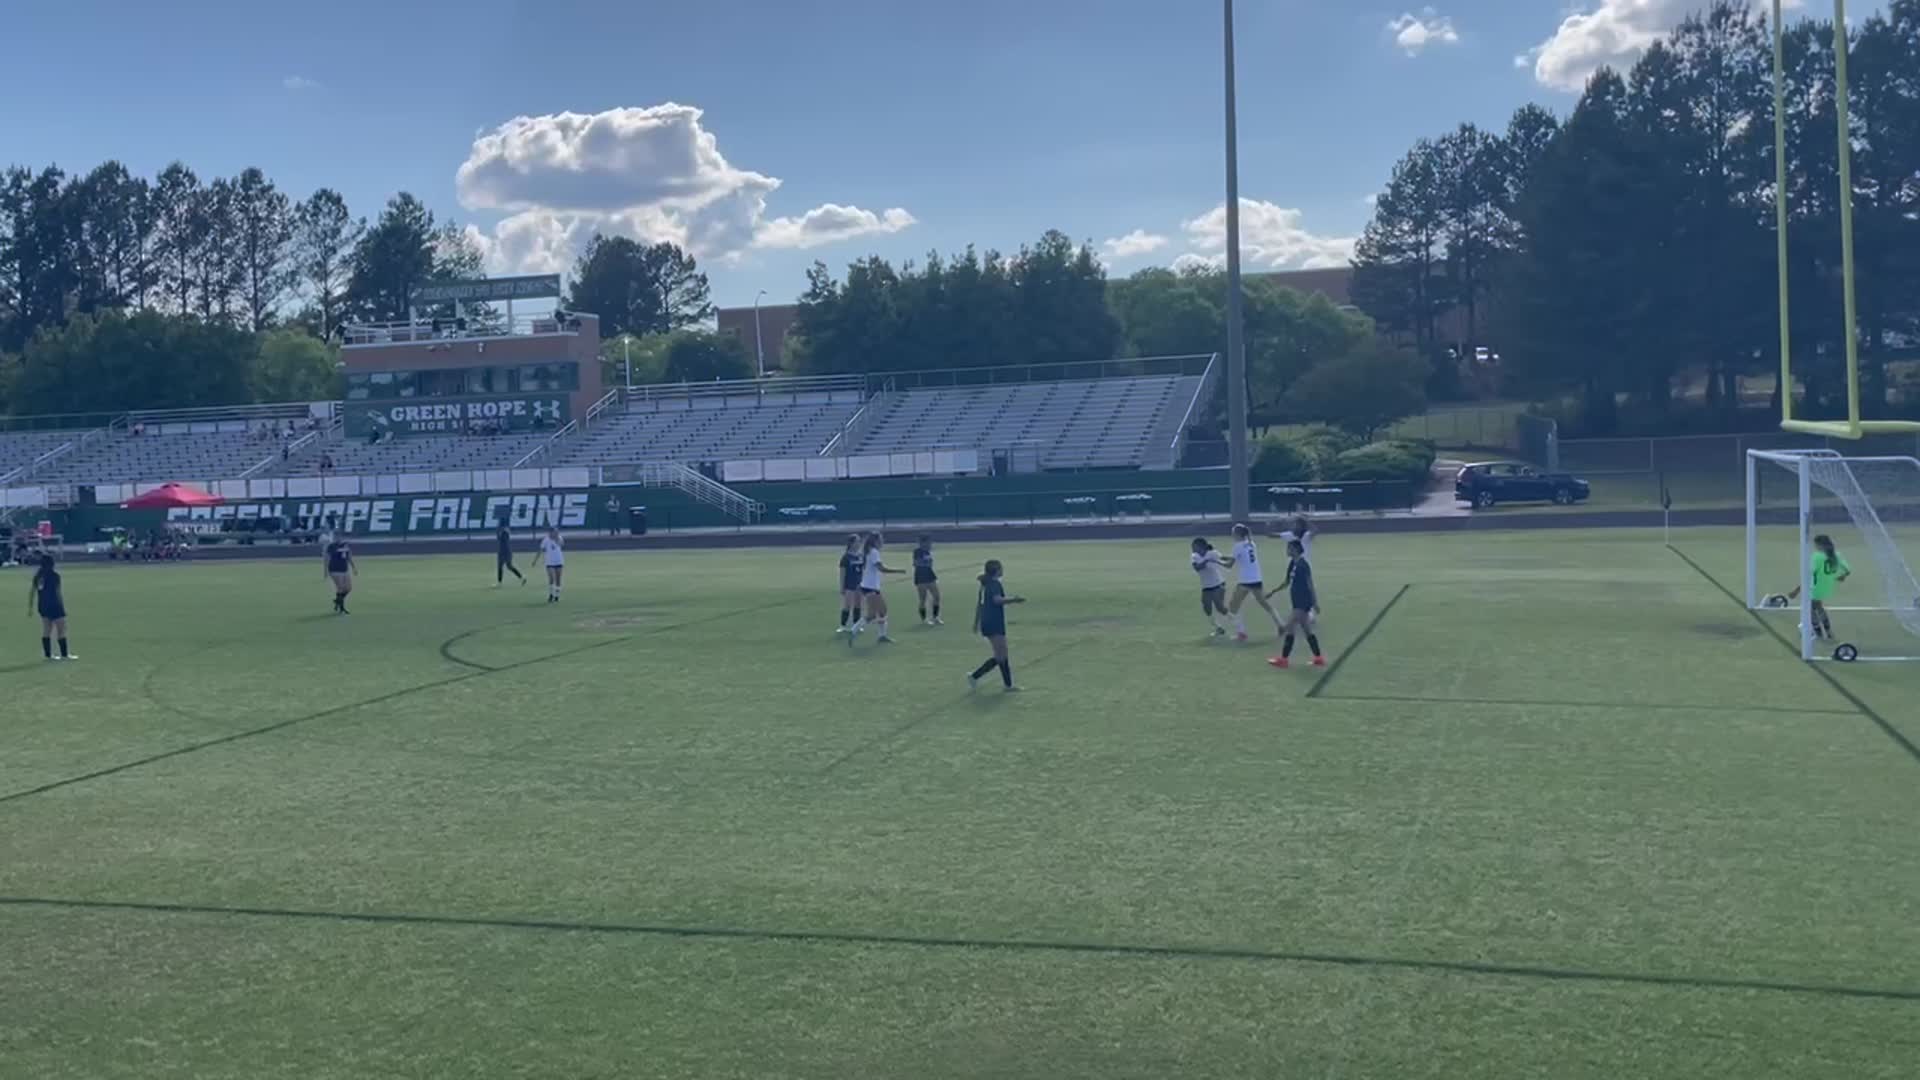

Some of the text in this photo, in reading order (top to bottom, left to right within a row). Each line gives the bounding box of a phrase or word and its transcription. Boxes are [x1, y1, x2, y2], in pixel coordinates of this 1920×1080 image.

[390, 401, 526, 422] GREEN HOPE
[411, 420, 446, 431] HIGH
[408, 494, 588, 530] FALCONS
